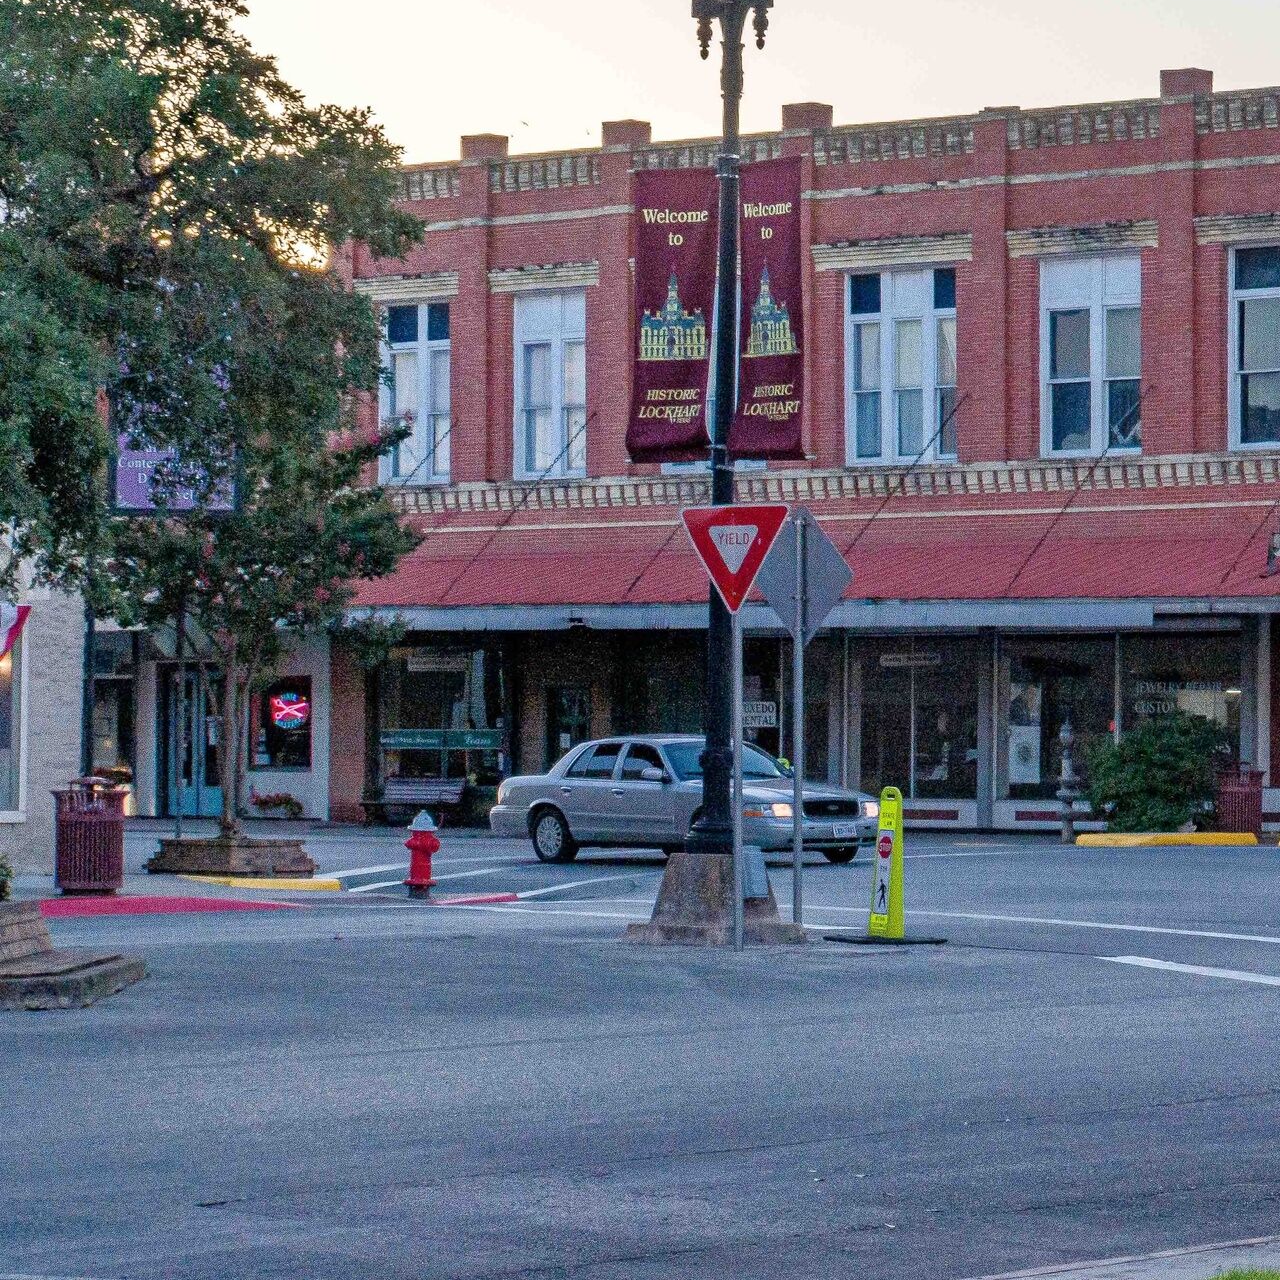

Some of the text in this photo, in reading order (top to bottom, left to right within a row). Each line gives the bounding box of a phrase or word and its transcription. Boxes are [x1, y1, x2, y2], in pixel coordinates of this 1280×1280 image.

[642, 208, 709, 224] Welcome
[743, 201, 793, 218] Welcome
[668, 231, 683, 246] to
[760, 225, 773, 240] to
[646, 388, 701, 401] HISTORIC
[753, 384, 794, 398] HISTORIC
[638, 404, 702, 420] LOCKHART
[743, 400, 800, 416] LOCKHART
[717, 532, 750, 545] YIELD
[743, 703, 775, 713] UXEDO
[742, 715, 775, 726] ENTAL
